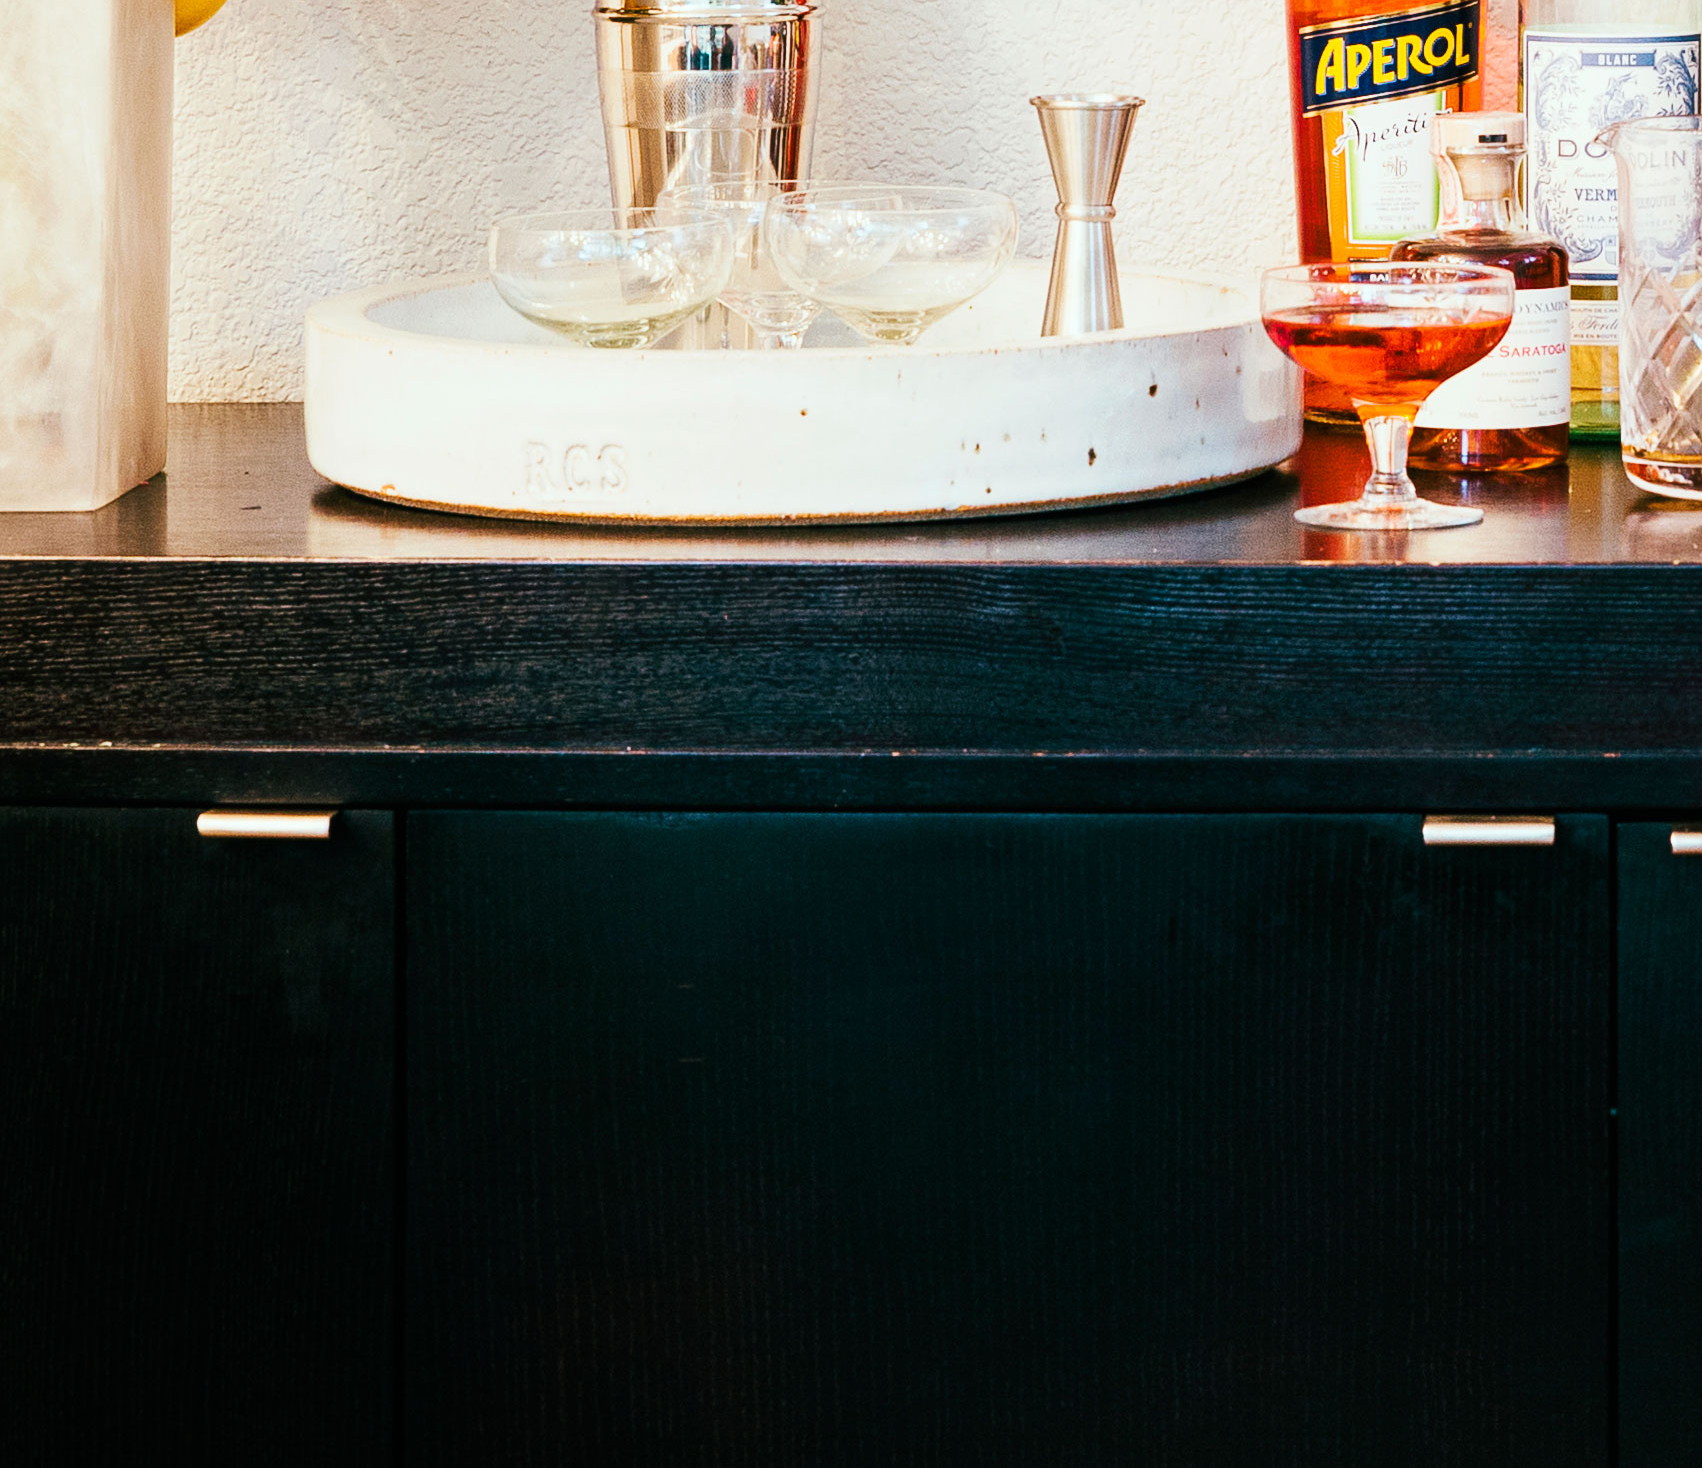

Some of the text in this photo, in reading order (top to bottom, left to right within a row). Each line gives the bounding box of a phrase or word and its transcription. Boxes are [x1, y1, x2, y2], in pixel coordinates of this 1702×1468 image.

[1315, 23, 1470, 96] APEROL
[1598, 54, 1638, 66] BLANC
[1332, 108, 1452, 162] Aperiti
[1499, 342, 1566, 359] SARATOGA
[525, 440, 629, 495] RCS
